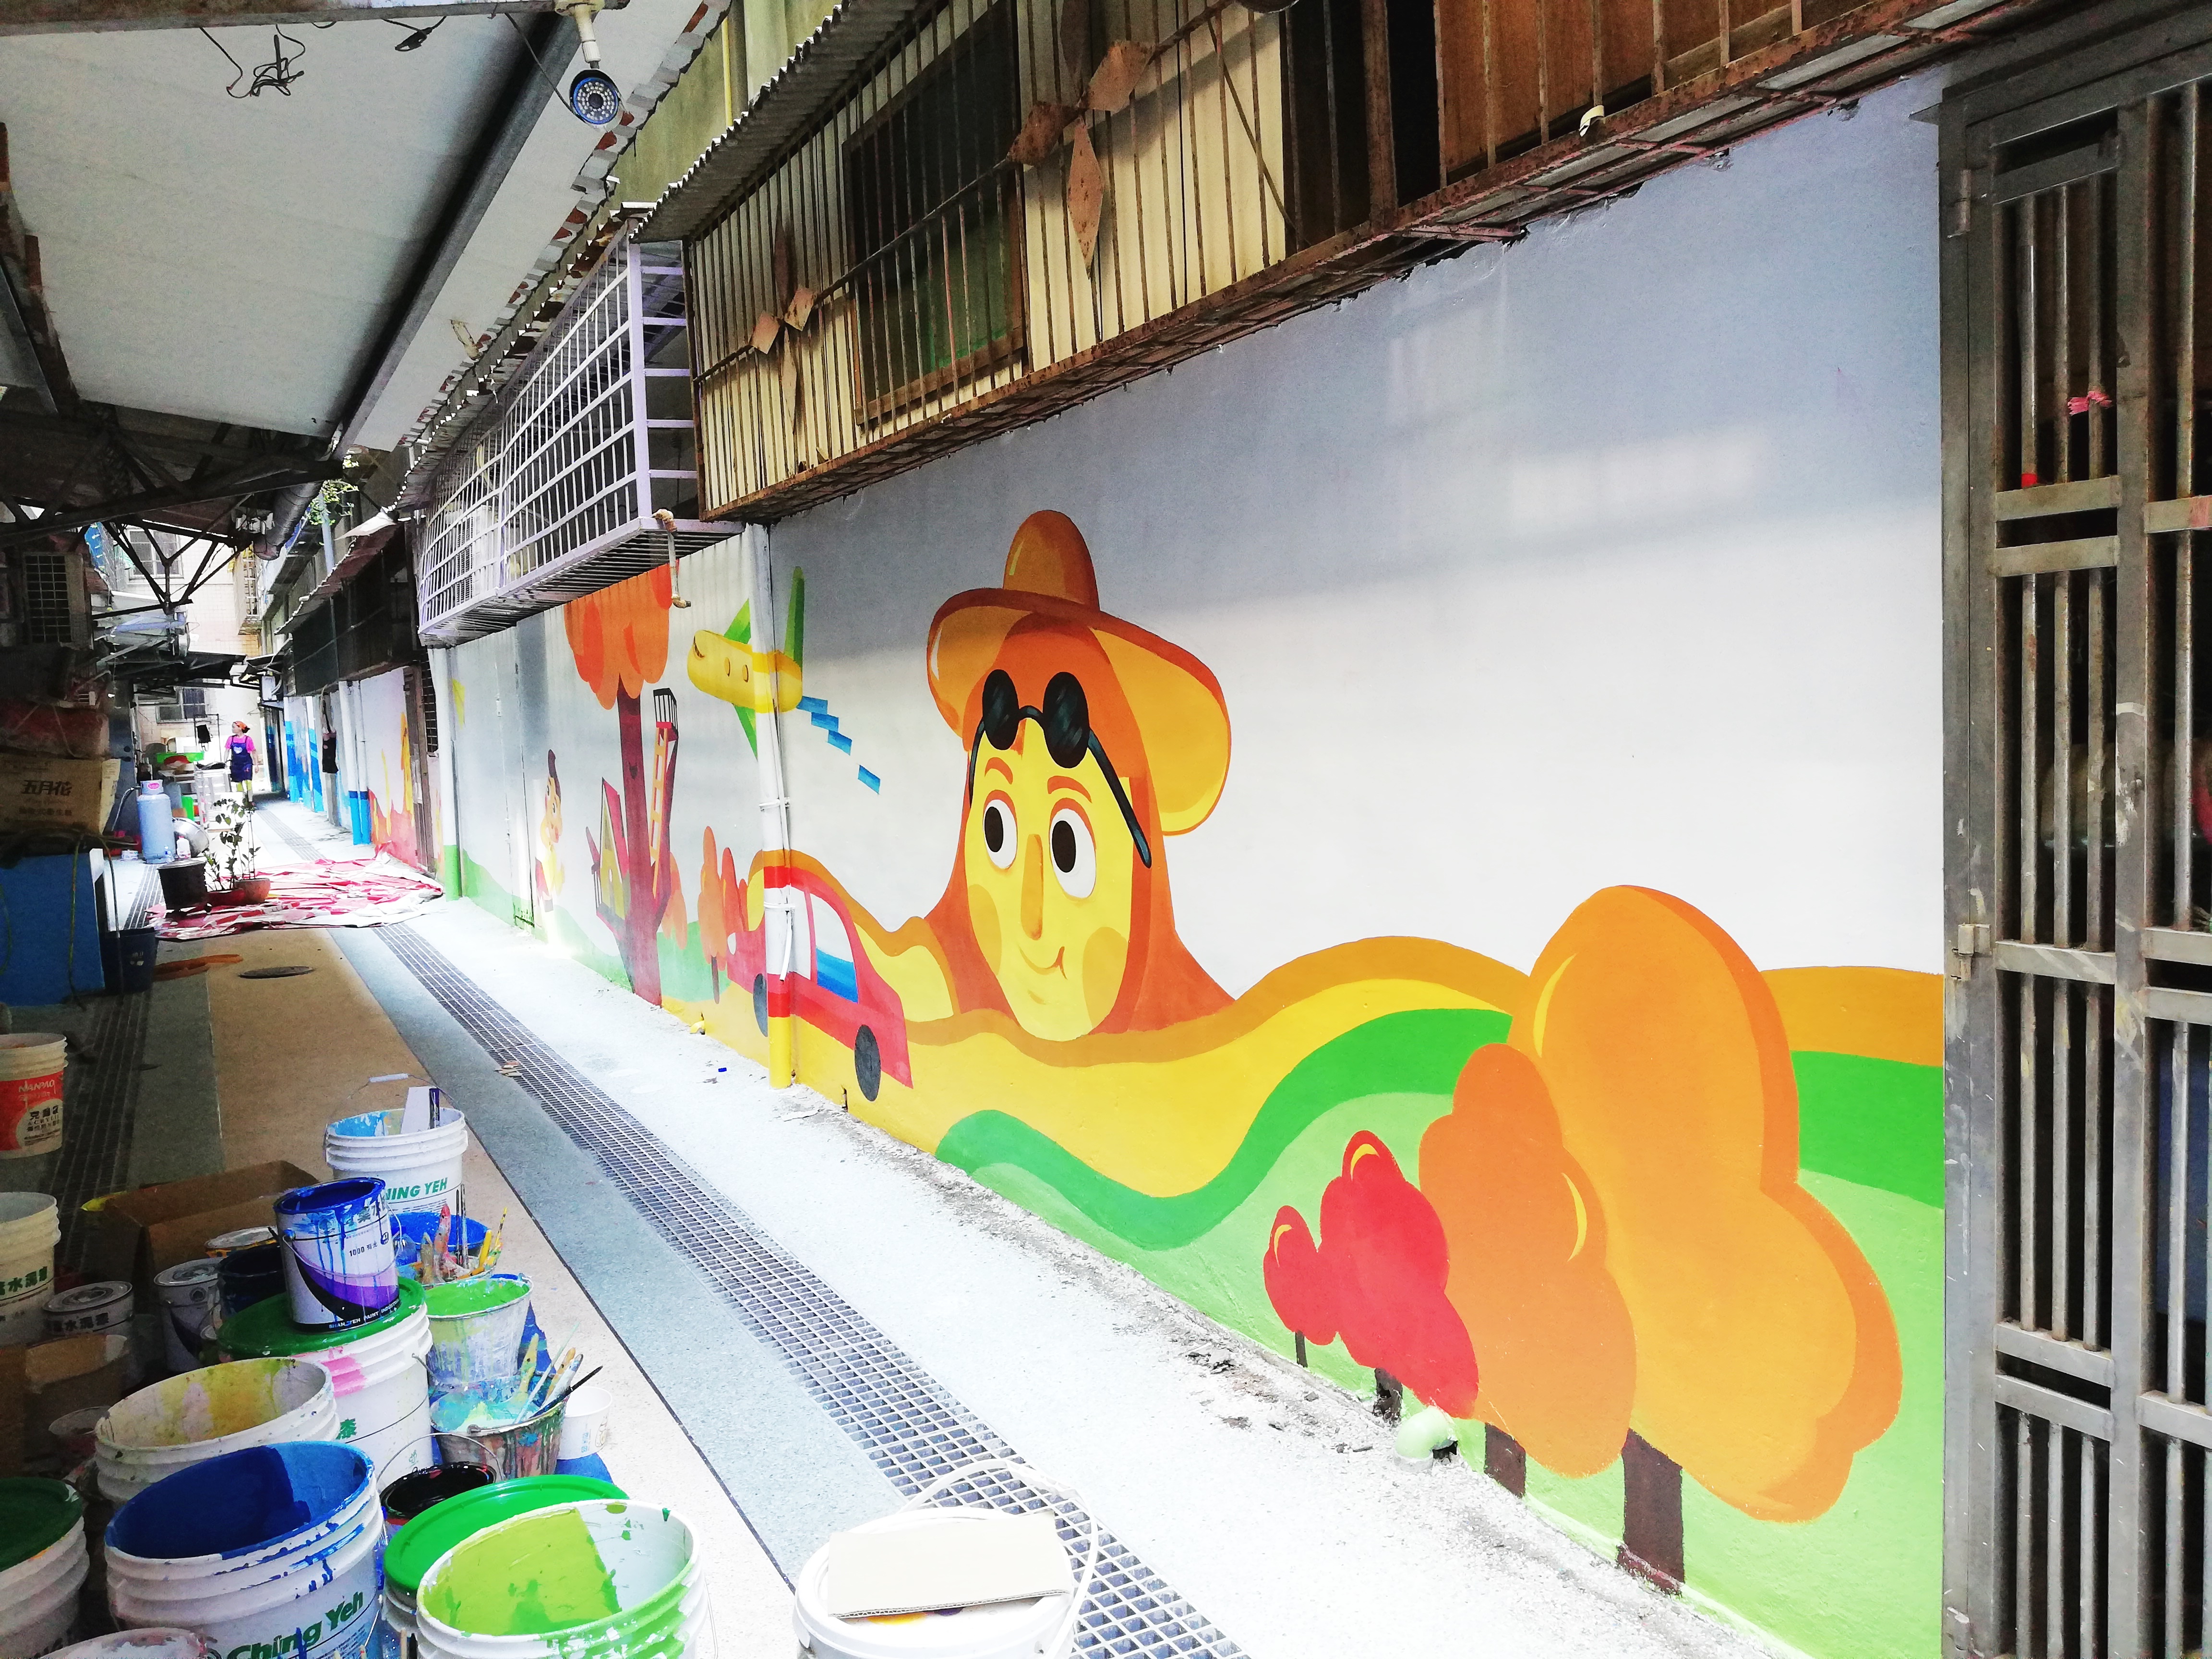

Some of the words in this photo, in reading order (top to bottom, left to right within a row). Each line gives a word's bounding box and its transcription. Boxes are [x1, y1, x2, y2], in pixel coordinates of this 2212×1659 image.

[21, 780, 72, 796] 五月花
[424, 1178, 448, 1195] YEH
[349, 1247, 365, 1257] 1000
